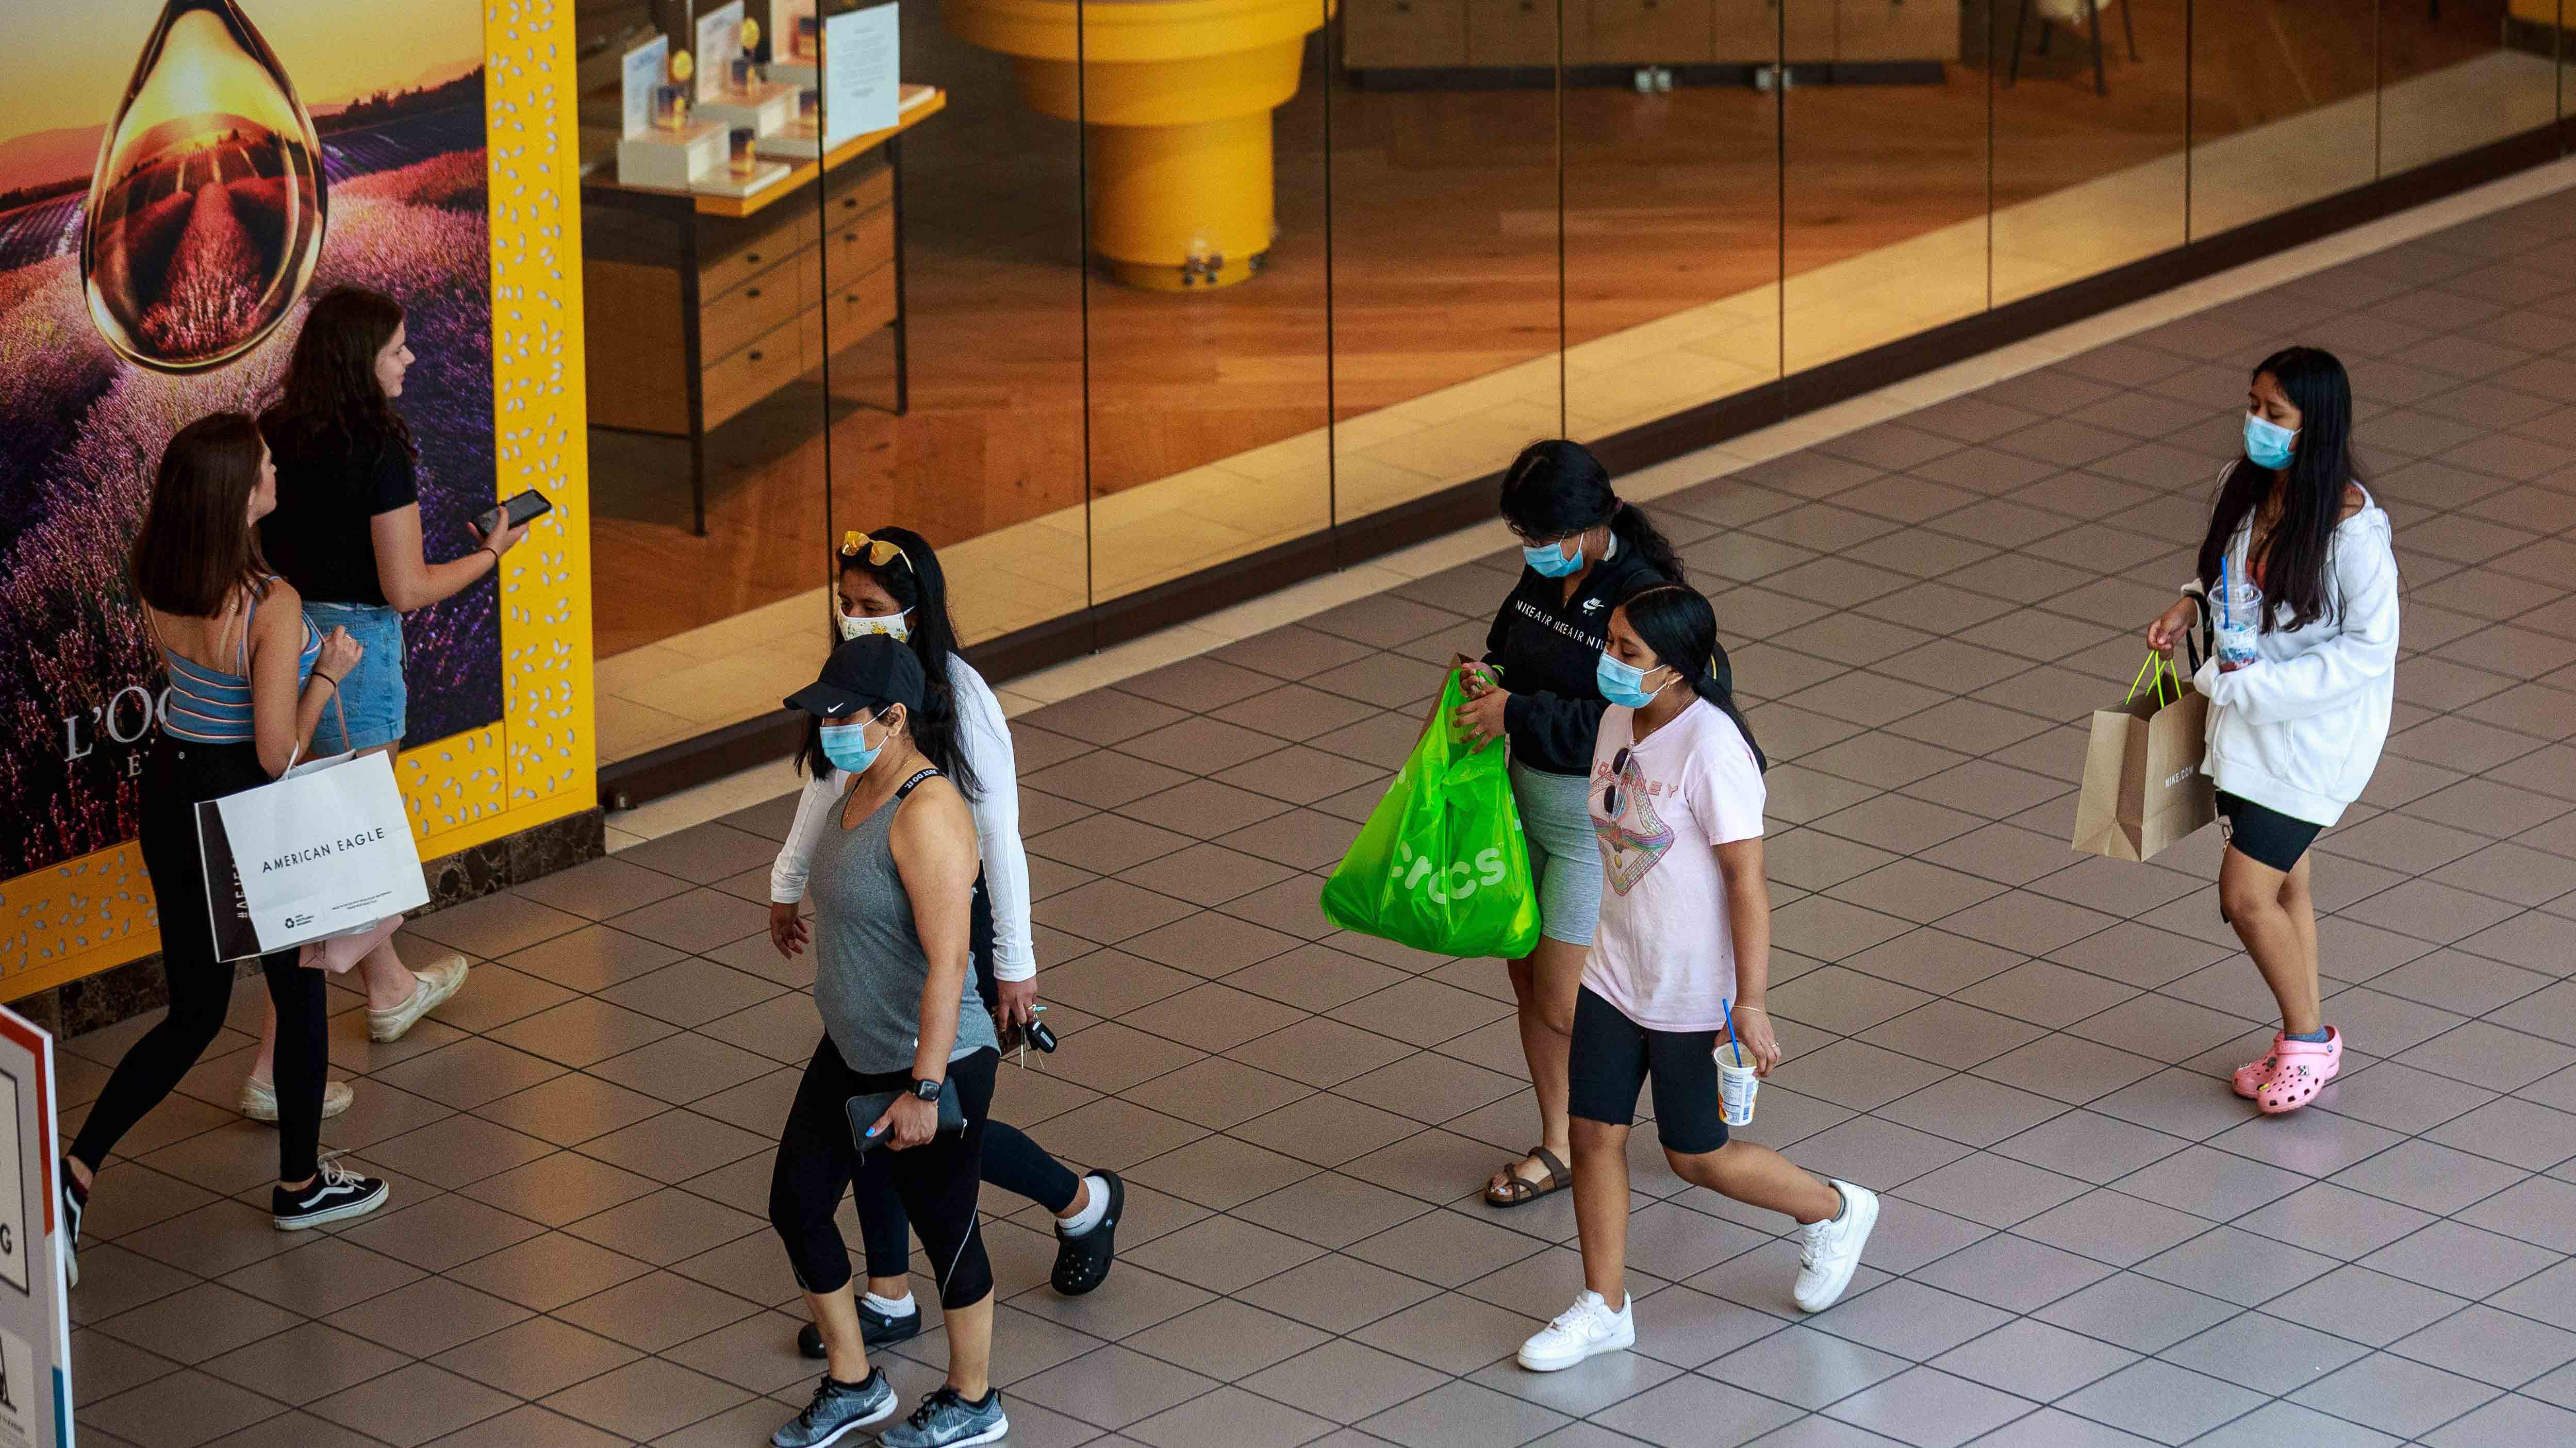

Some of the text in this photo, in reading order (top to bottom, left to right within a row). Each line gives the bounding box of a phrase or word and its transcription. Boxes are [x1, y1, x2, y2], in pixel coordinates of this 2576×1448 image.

[912, 774, 923, 783] DO
[262, 827, 385, 874] AMERICAN EAGLE
